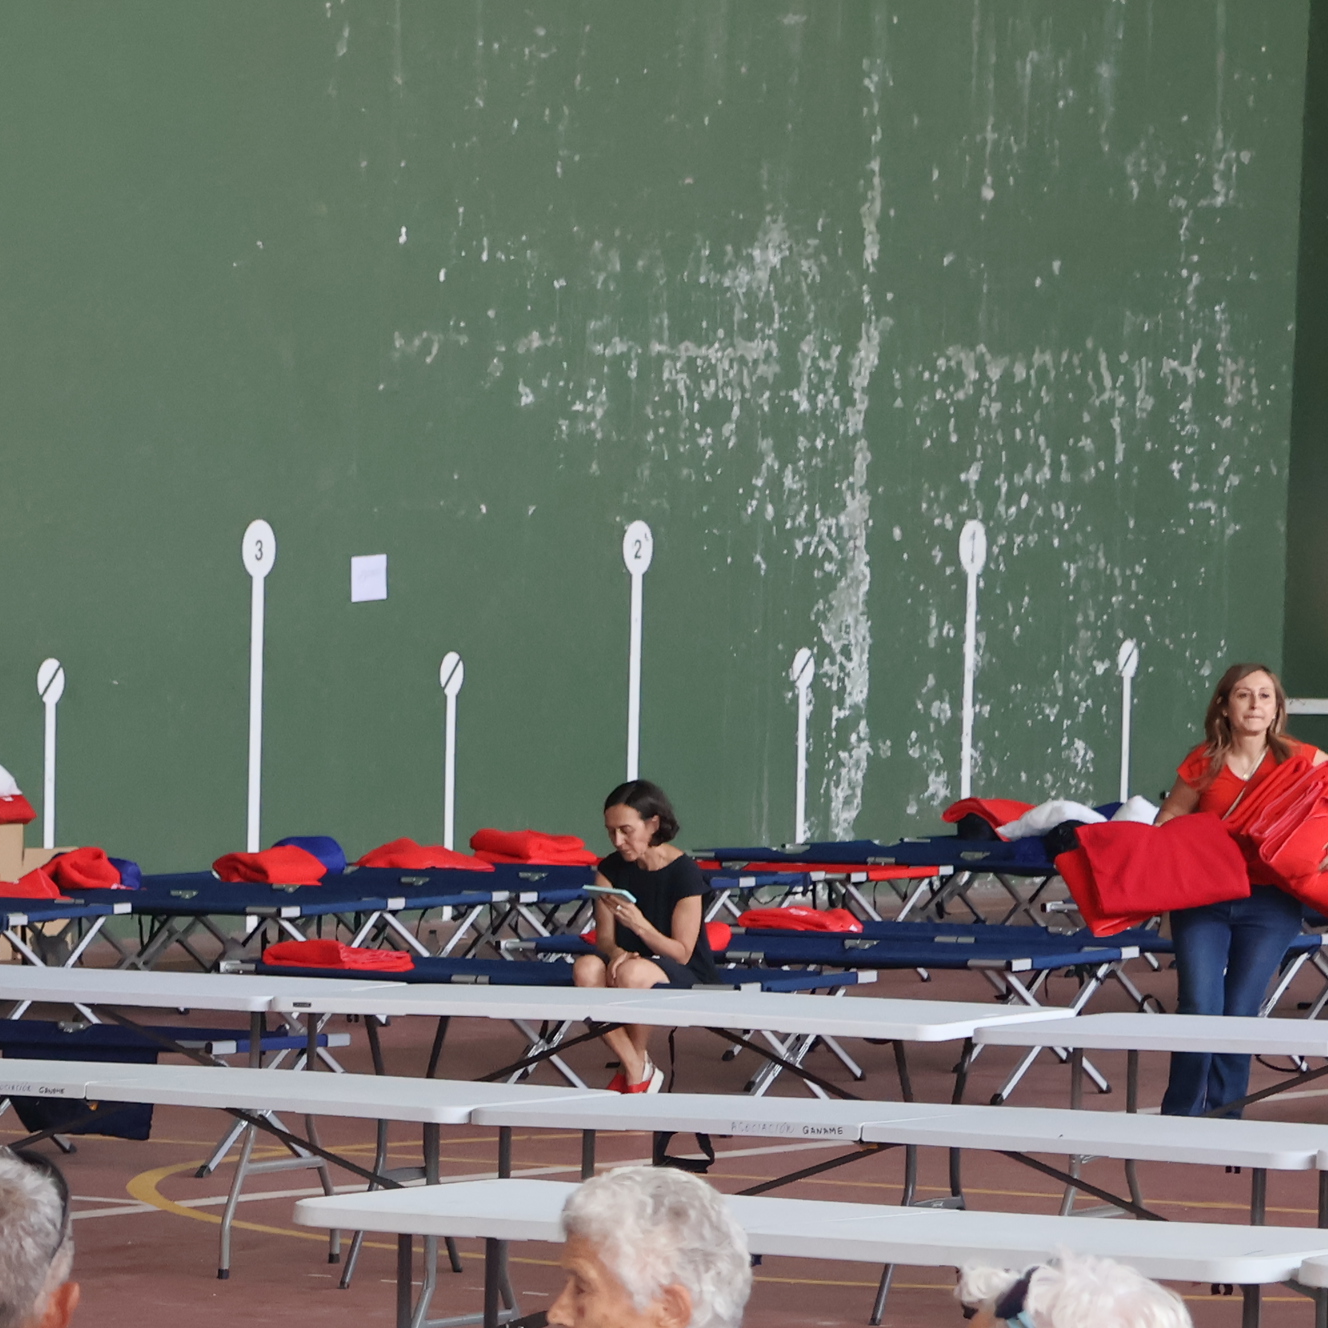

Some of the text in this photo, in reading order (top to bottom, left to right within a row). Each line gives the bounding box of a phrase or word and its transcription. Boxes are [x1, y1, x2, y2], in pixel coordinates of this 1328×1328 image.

[254, 539, 264, 561] 3
[633, 539, 643, 560] 2
[967, 529, 977, 564] 1
[802, 1125, 844, 1135] GANAME
